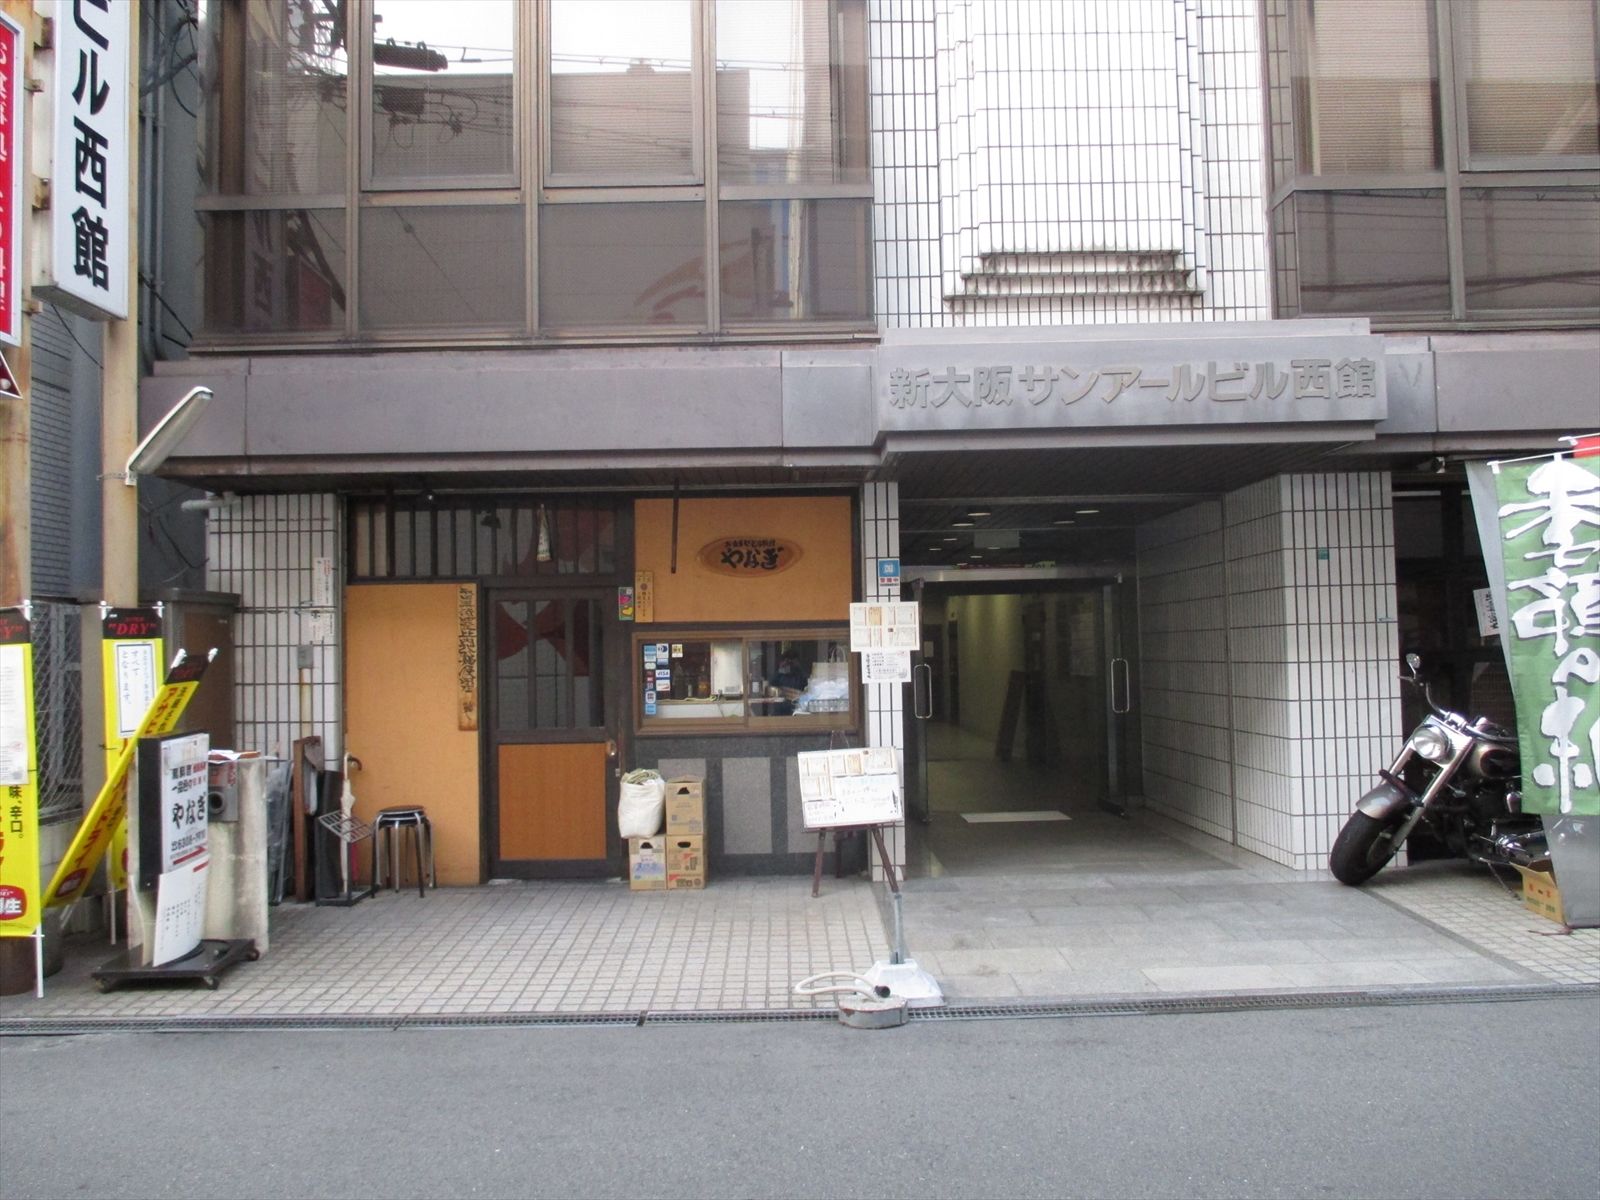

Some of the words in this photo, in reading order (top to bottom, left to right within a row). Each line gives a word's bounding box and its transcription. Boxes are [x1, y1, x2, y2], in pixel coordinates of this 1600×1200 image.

[888, 356, 1377, 410] 新大阪サンアールビル西館
[720, 546, 784, 570] やなぎ
[9, 785, 24, 839] 味、辛口。
[172, 792, 207, 829] やなぎ
